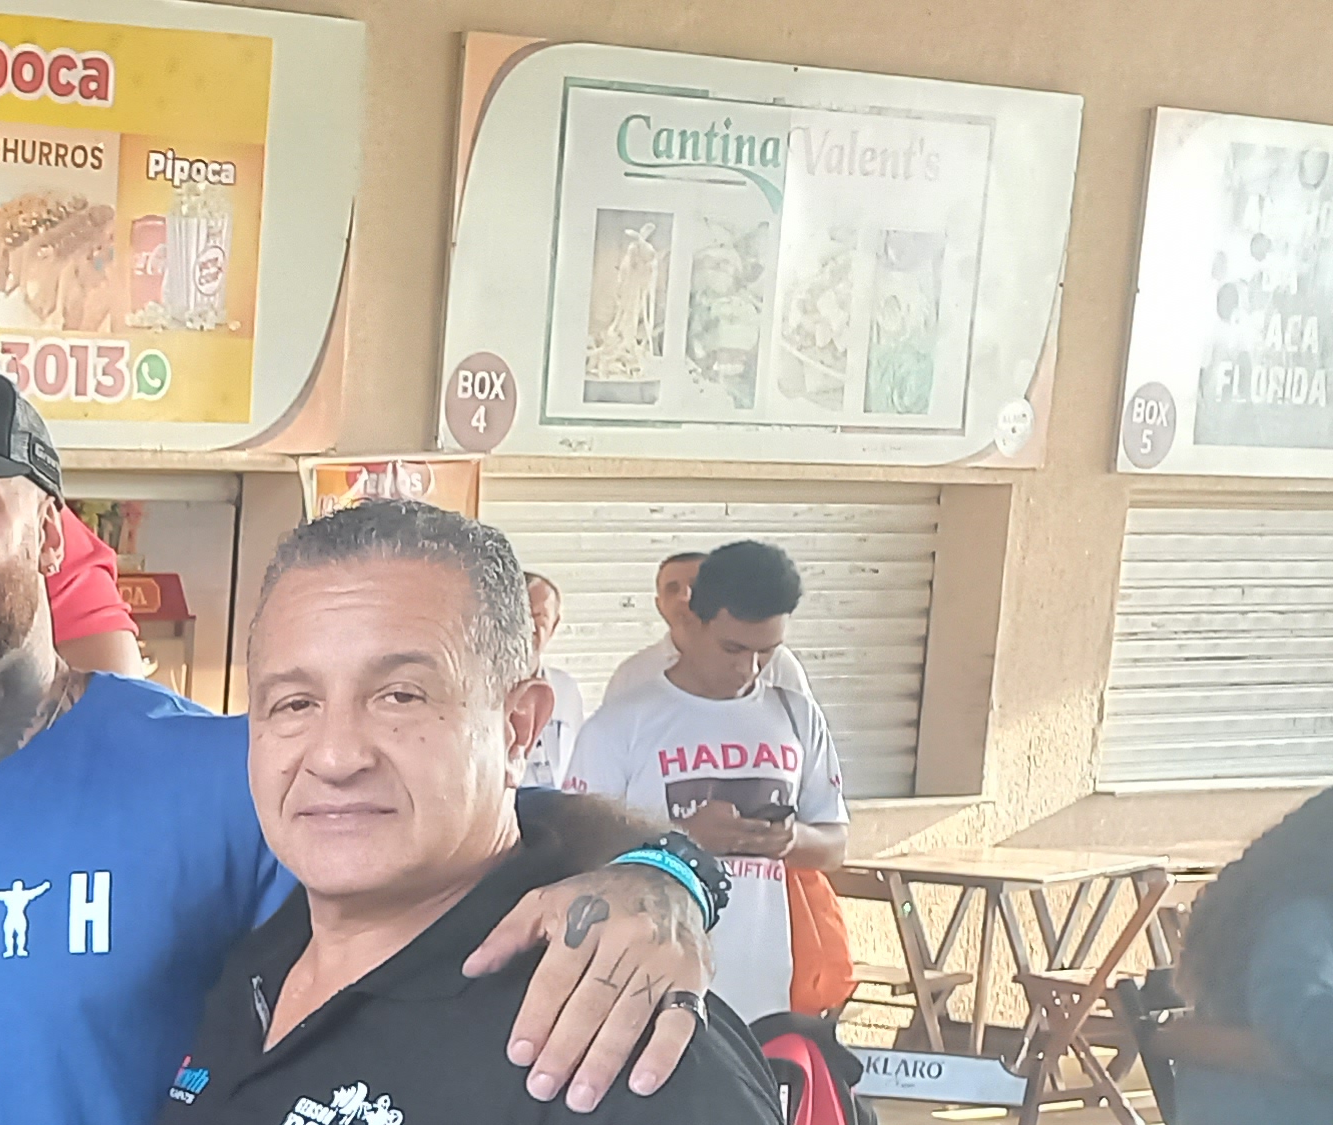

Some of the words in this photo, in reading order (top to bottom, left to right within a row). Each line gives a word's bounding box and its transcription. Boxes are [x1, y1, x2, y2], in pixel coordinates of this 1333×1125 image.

[616, 113, 782, 169] Cantina
[787, 125, 941, 182] Valent's
[147, 147, 237, 187] Pipoca
[457, 369, 507, 401] BOX
[1216, 359, 1328, 407] FLORIDA
[470, 404, 487, 434] 4
[1132, 396, 1170, 427] BOX
[1140, 429, 1153, 454] 5
[658, 742, 799, 778] HADAD
[865, 1055, 945, 1080] KLARO
